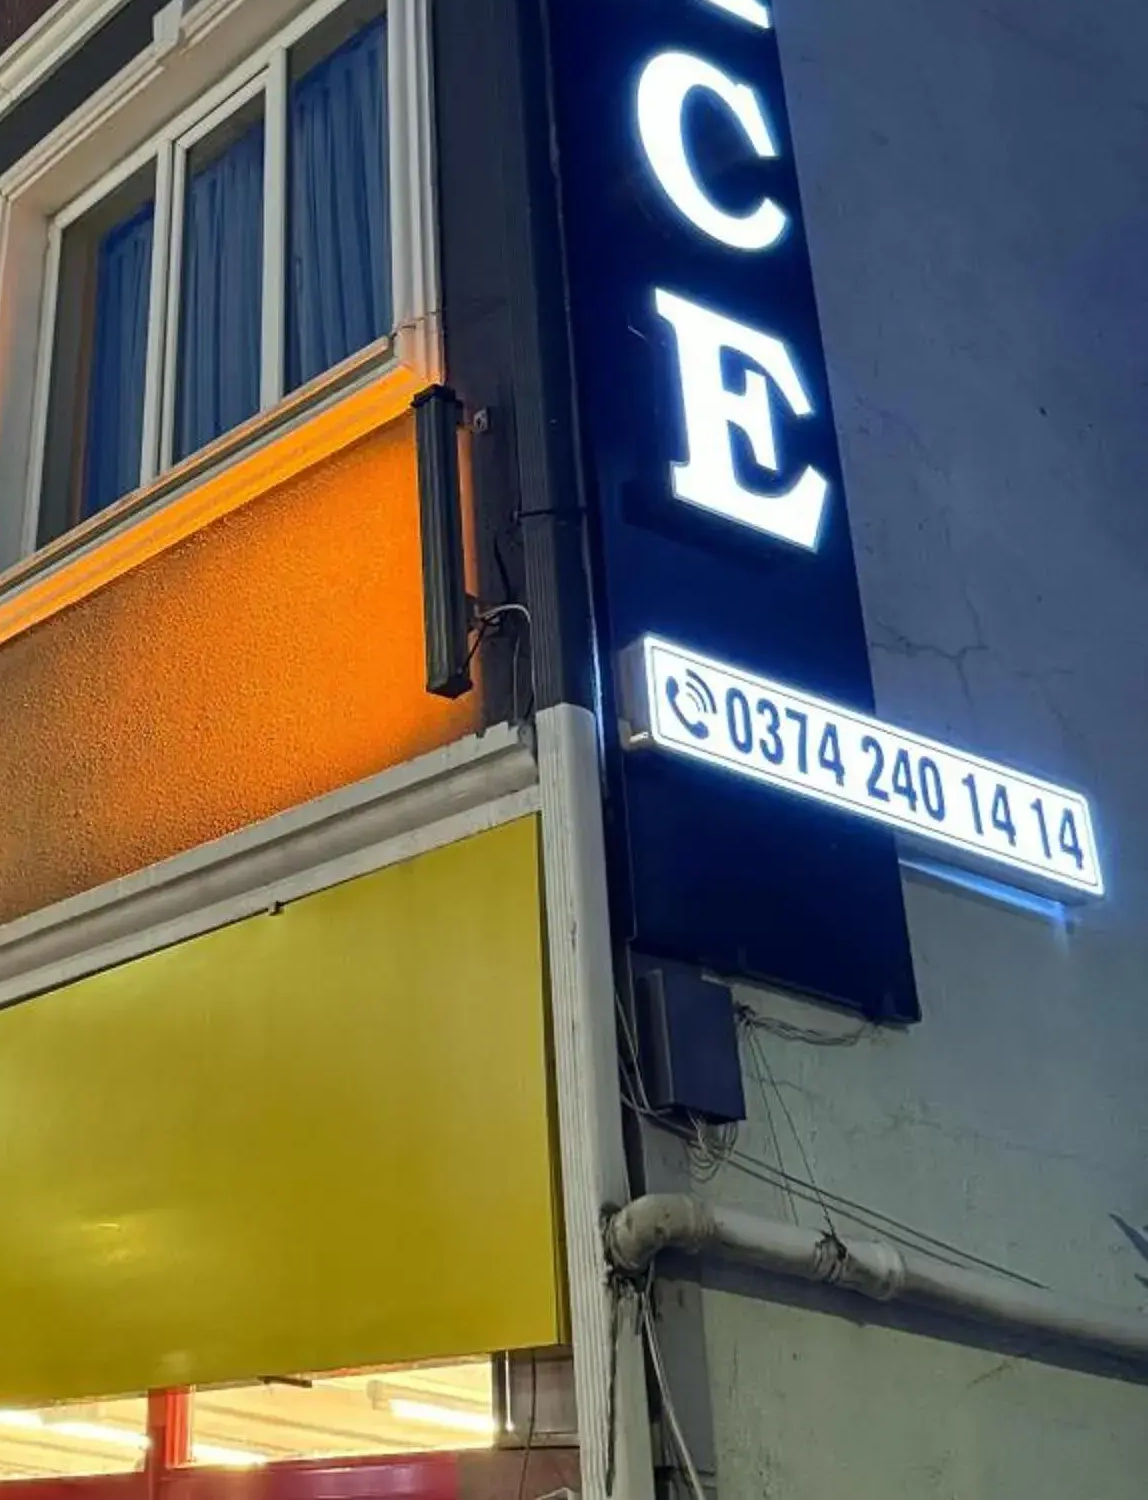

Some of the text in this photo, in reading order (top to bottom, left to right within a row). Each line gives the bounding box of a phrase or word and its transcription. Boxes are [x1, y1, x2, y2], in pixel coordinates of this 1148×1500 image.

[725, 687, 1084, 870] 0374 240 14 14
